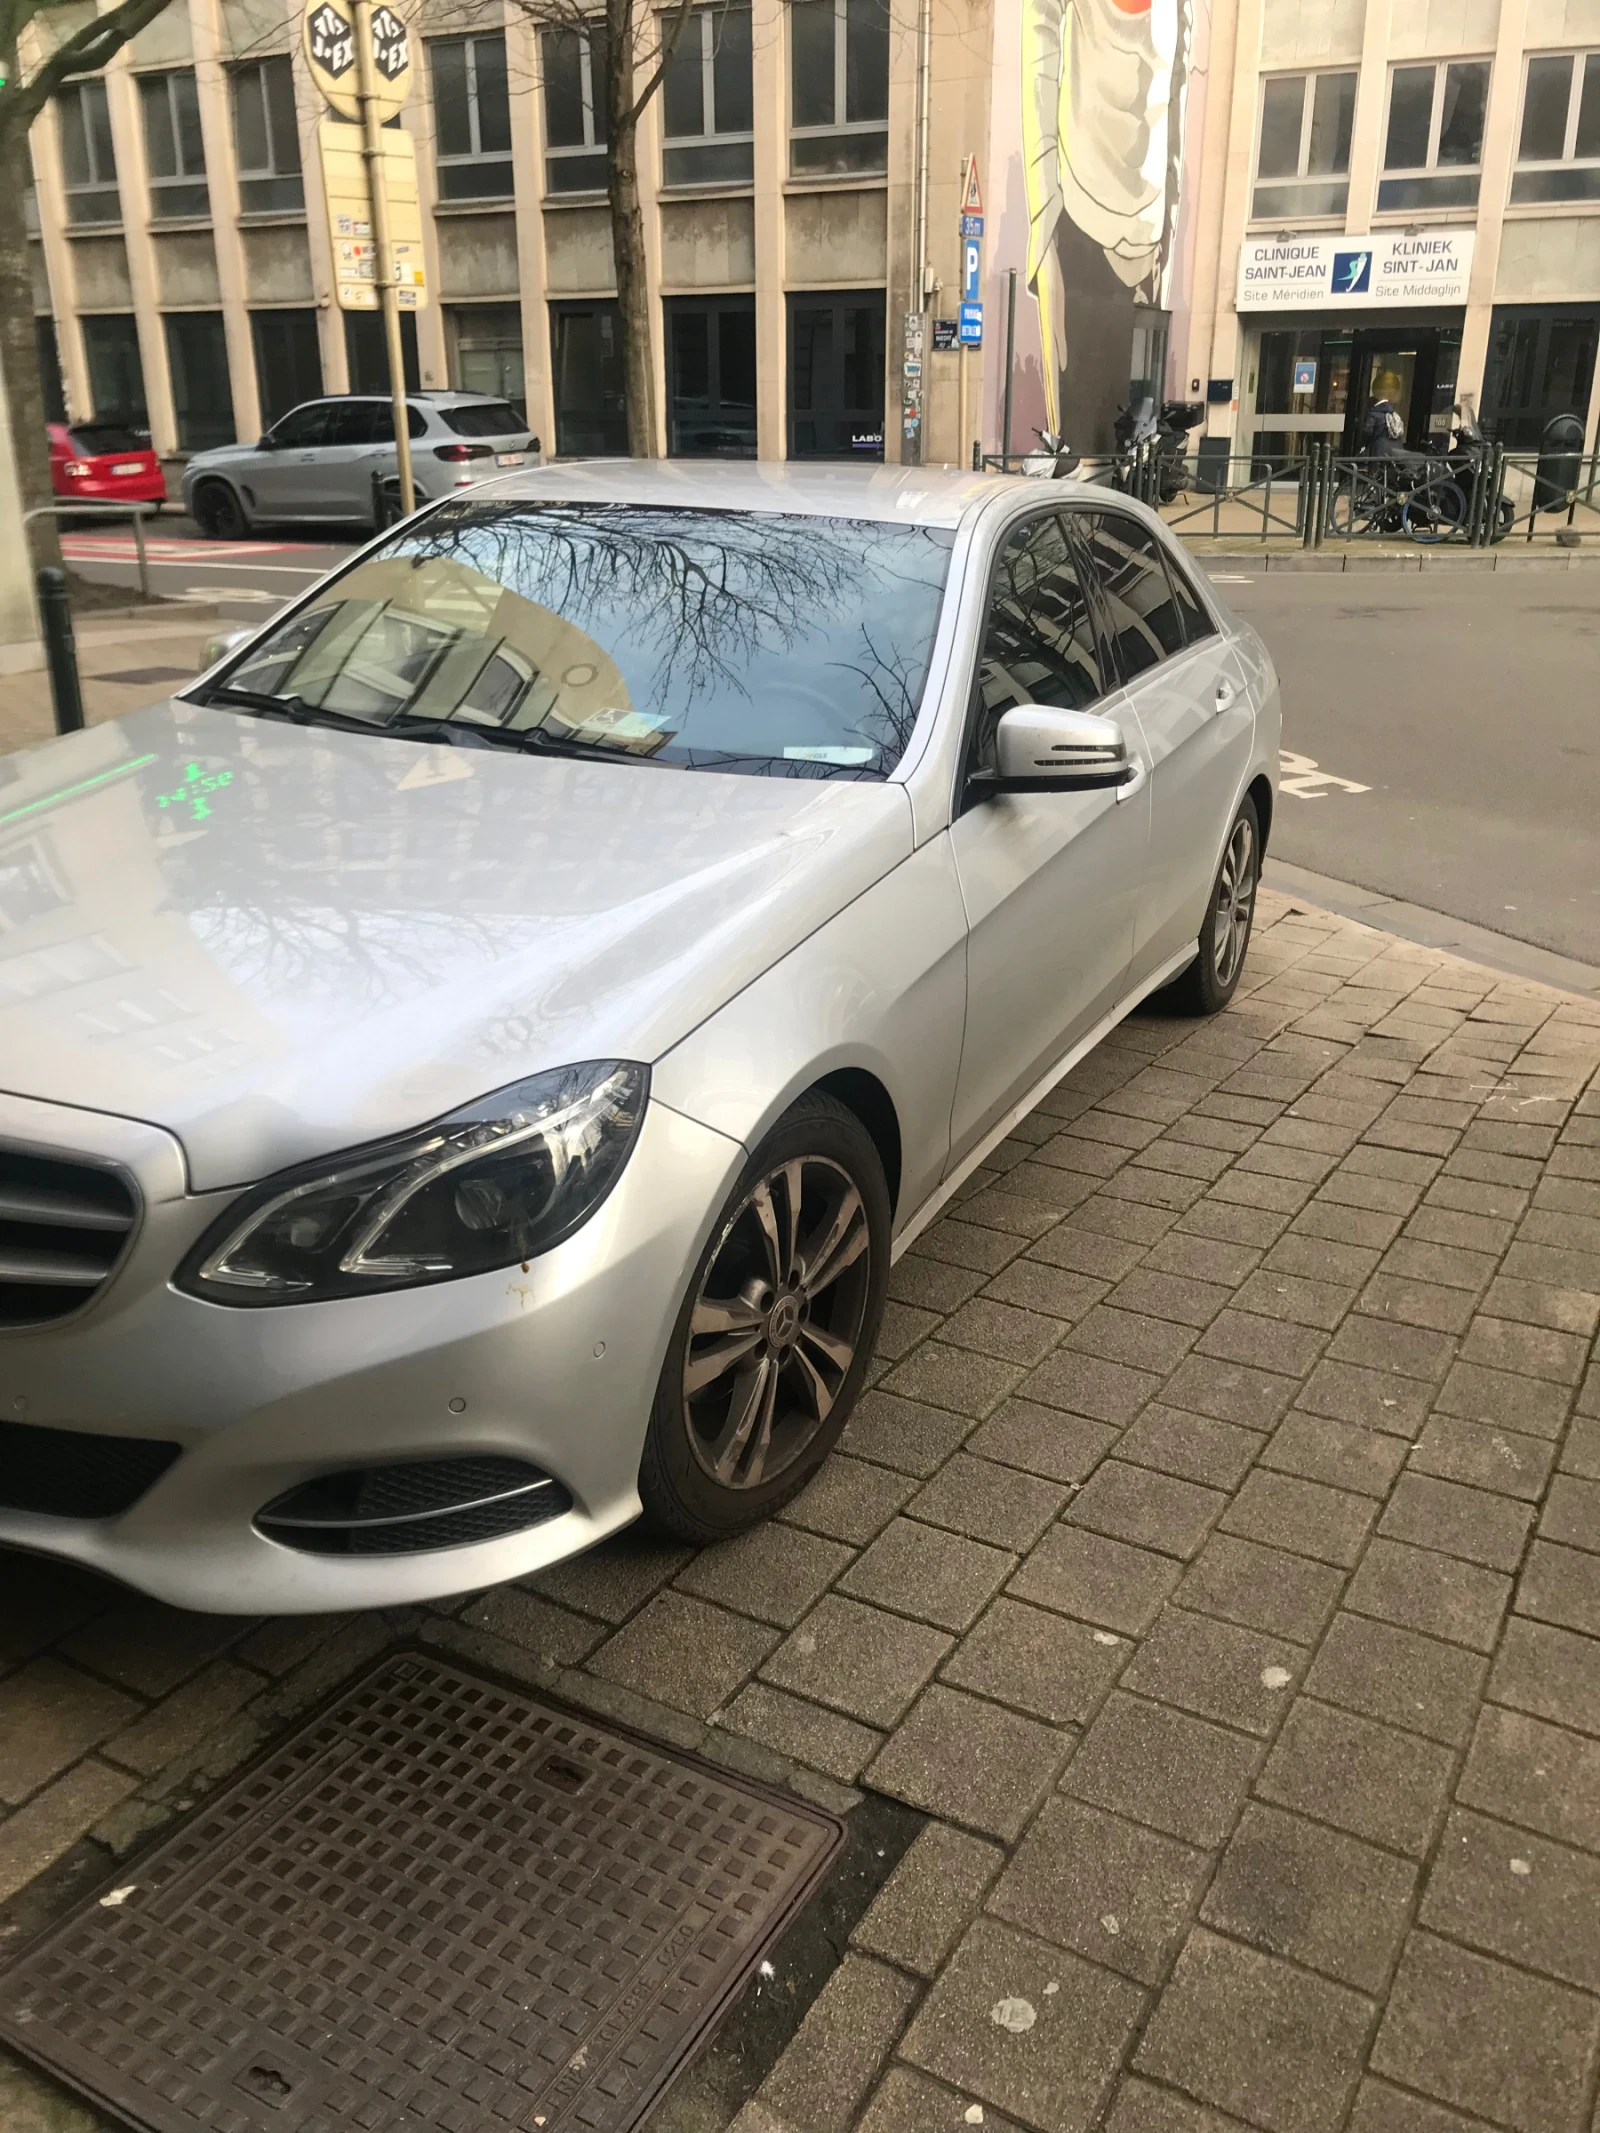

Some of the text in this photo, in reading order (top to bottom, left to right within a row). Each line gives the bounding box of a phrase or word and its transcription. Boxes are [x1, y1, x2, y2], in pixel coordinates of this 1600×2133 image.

[1254, 246, 1320, 261] CLINIQUE
[1392, 240, 1453, 256] KLINIEK
[966, 246, 979, 291] P
[1245, 265, 1327, 280] SAINT-JEAN
[1243, 288, 1324, 301] Site Méridien
[1375, 283, 1461, 297] Site Middaglijn
